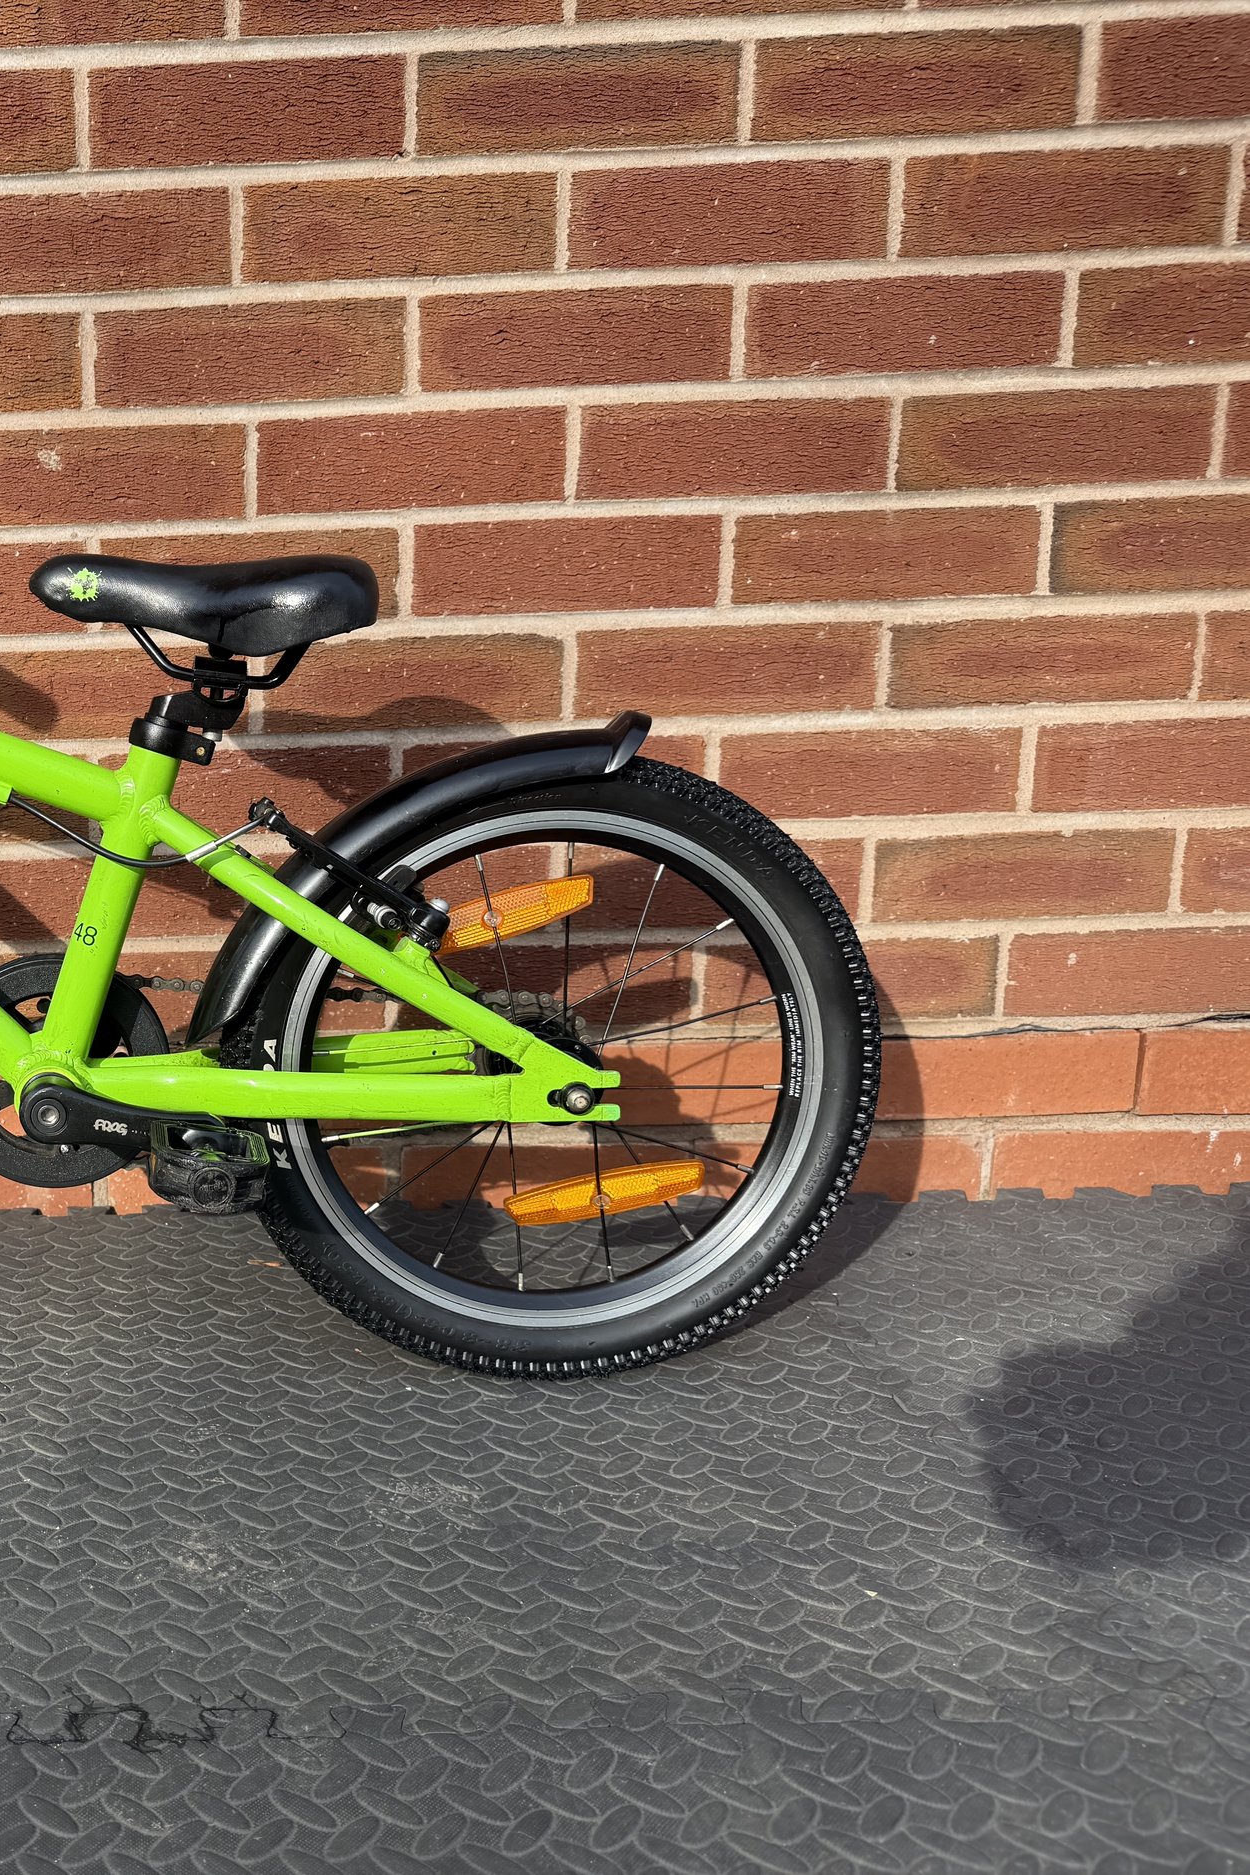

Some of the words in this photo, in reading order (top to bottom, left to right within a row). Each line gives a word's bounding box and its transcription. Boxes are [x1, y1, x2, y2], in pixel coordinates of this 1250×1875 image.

[683, 810, 774, 878] KENDA
[73, 922, 98, 946] 48
[781, 993, 790, 1011] WORN
[787, 993, 801, 1036] IMMEDIATELY
[794, 1069, 802, 1097] REPLACE
[263, 1039, 292, 1169] KEA
[93, 1119, 128, 1136] FROG
